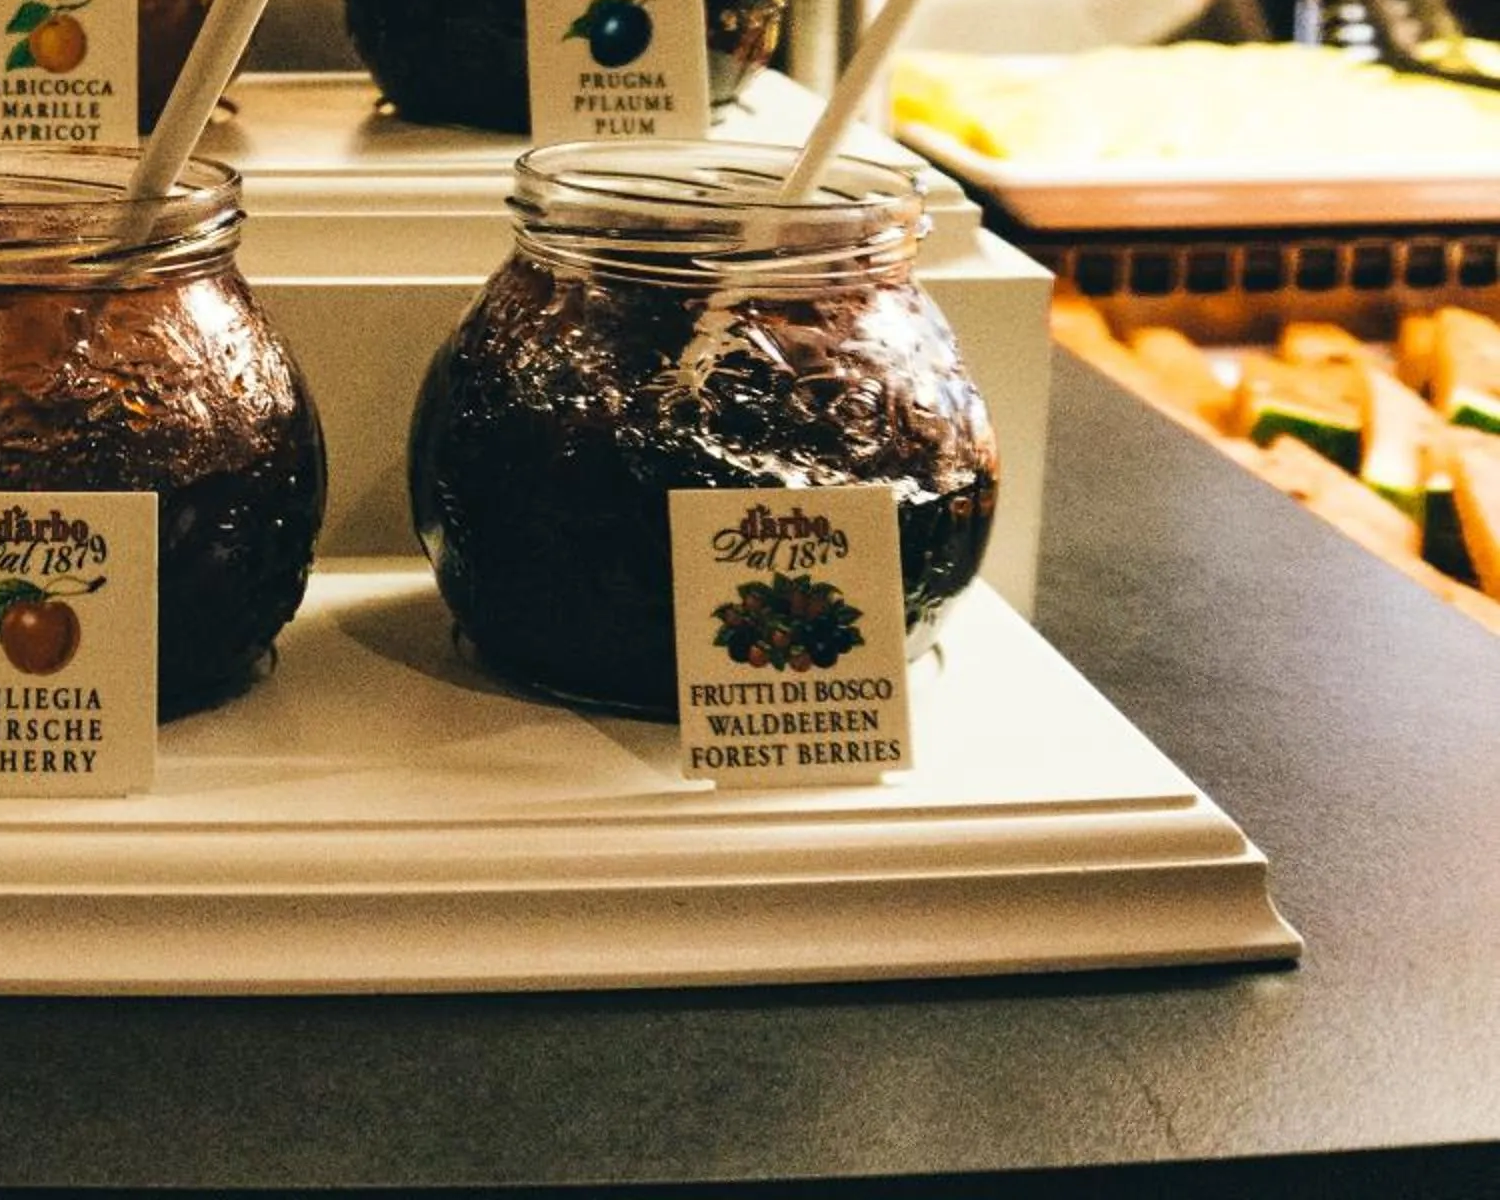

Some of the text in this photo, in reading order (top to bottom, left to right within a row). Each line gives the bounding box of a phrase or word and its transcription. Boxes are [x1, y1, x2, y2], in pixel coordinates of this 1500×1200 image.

[580, 73, 666, 89] PRUGNA
[3, 102, 100, 119] MARILLE
[574, 94, 674, 111] PFLAUME
[0, 125, 99, 141] APRICOT
[595, 118, 655, 134] PLUM
[41, 534, 108, 575] 1879
[712, 528, 849, 571] Dal 1879
[690, 677, 894, 706] FRUTTI DI BOSCO
[707, 709, 880, 736] WALDBEEREN
[691, 738, 901, 769] FOREST BERRIES
